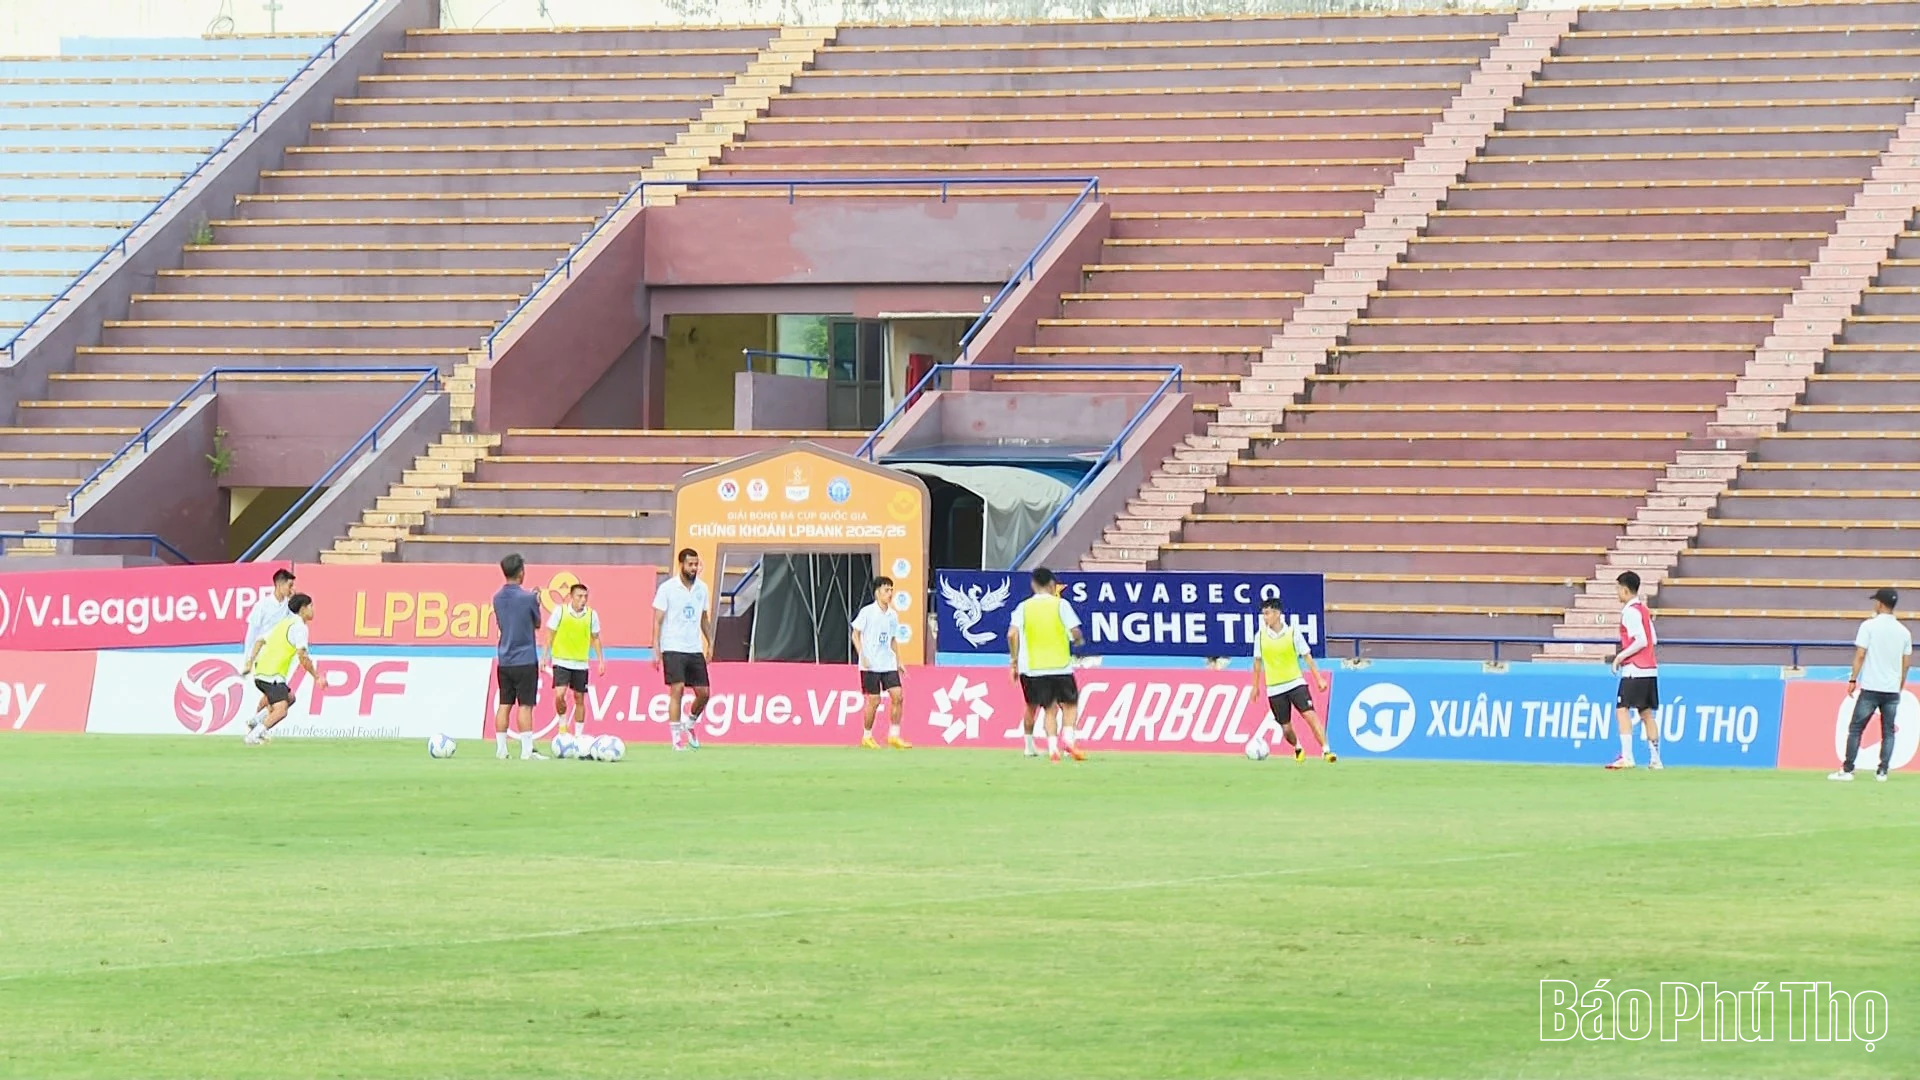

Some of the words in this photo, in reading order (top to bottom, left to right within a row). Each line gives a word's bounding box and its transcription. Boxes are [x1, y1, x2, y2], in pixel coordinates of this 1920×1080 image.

[689, 521, 736, 537] CHỨNG
[739, 522, 785, 537] KHOÁN
[789, 523, 843, 537] LPBANK
[845, 524, 906, 538] 2025/26
[1072, 582, 1281, 604] SAVABECO
[1091, 611, 1207, 644] NGHE
[1426, 692, 1513, 738] XUÂN
[1521, 694, 1612, 749] THIỆN
[1695, 705, 1759, 753] THỌ
